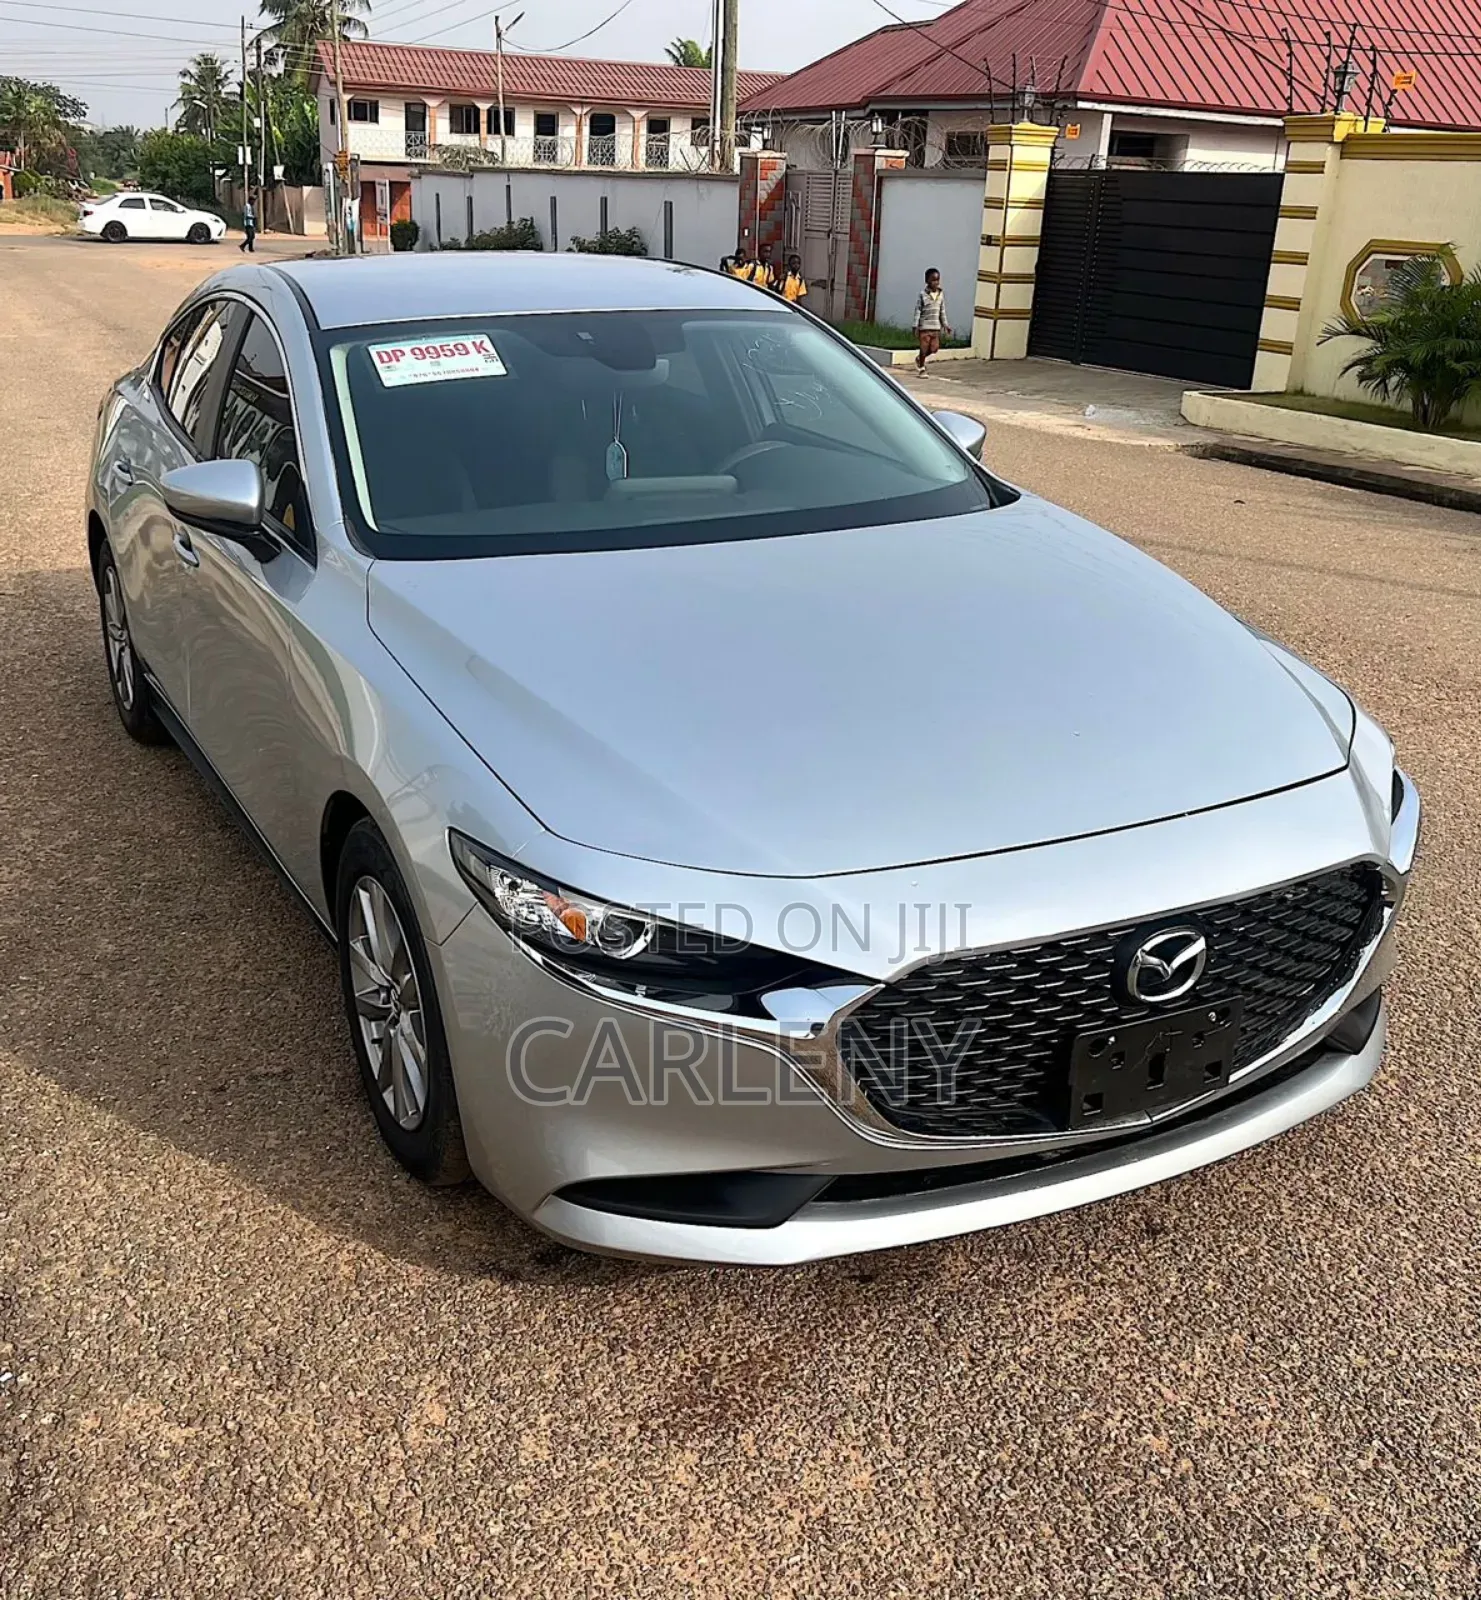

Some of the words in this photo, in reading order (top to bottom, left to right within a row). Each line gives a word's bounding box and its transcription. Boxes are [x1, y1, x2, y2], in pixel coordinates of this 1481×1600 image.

[375, 349, 406, 364] DP
[410, 342, 470, 360] 9959
[472, 340, 490, 354] K
